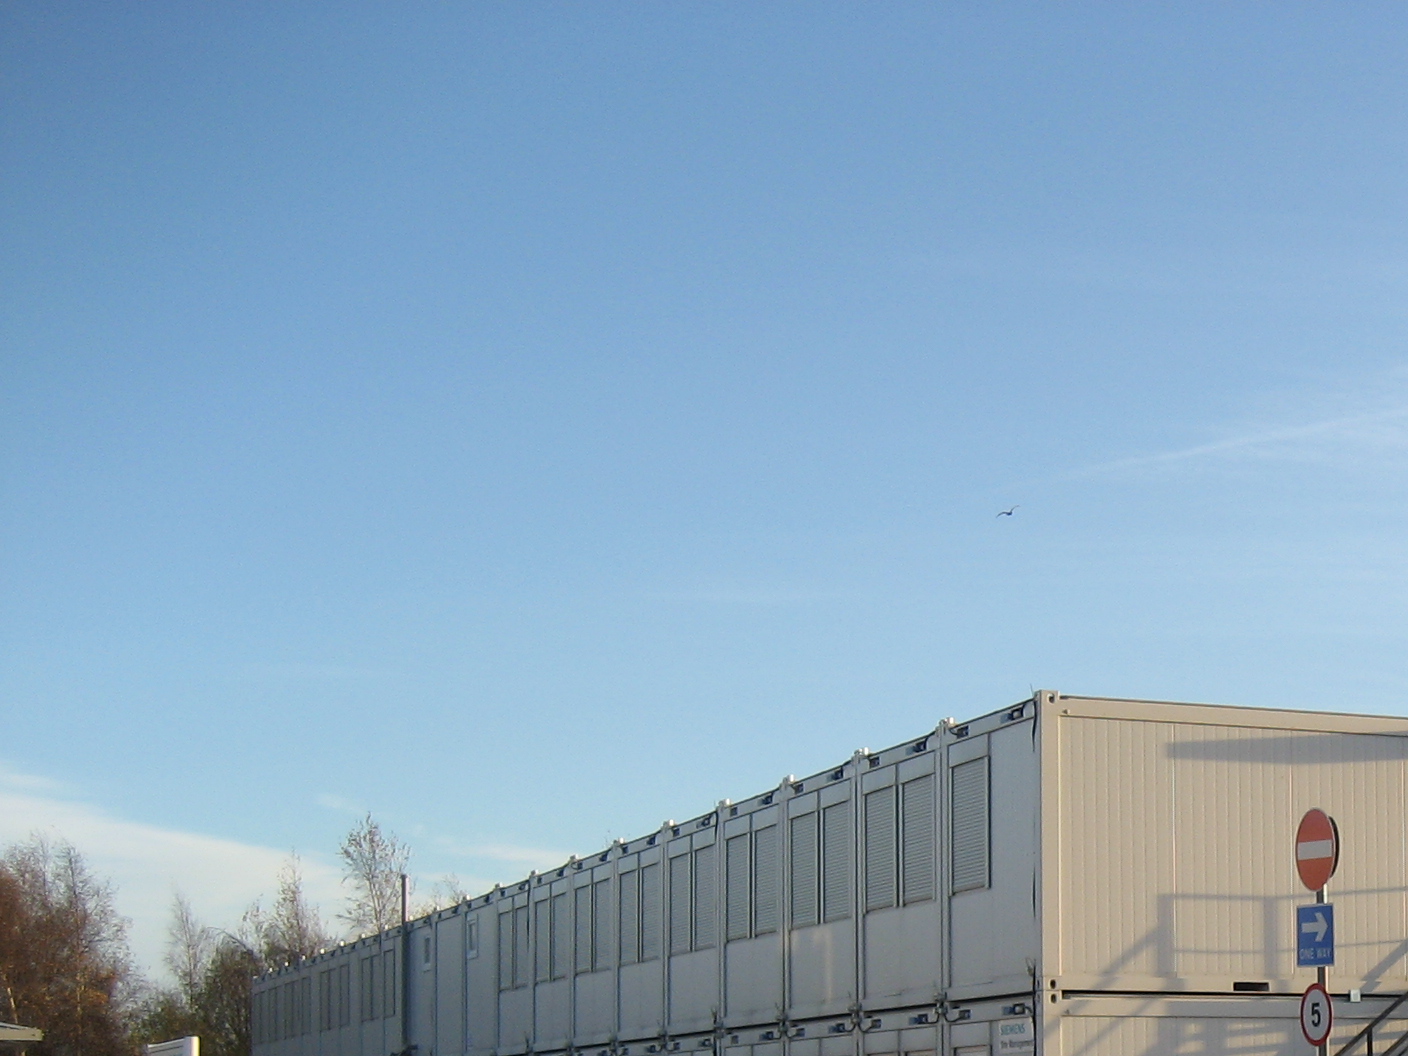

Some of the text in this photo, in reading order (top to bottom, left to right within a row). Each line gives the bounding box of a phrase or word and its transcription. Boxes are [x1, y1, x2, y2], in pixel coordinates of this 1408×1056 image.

[1299, 947, 1331, 960] ONE WAY
[1310, 1002, 1321, 1027] 5
